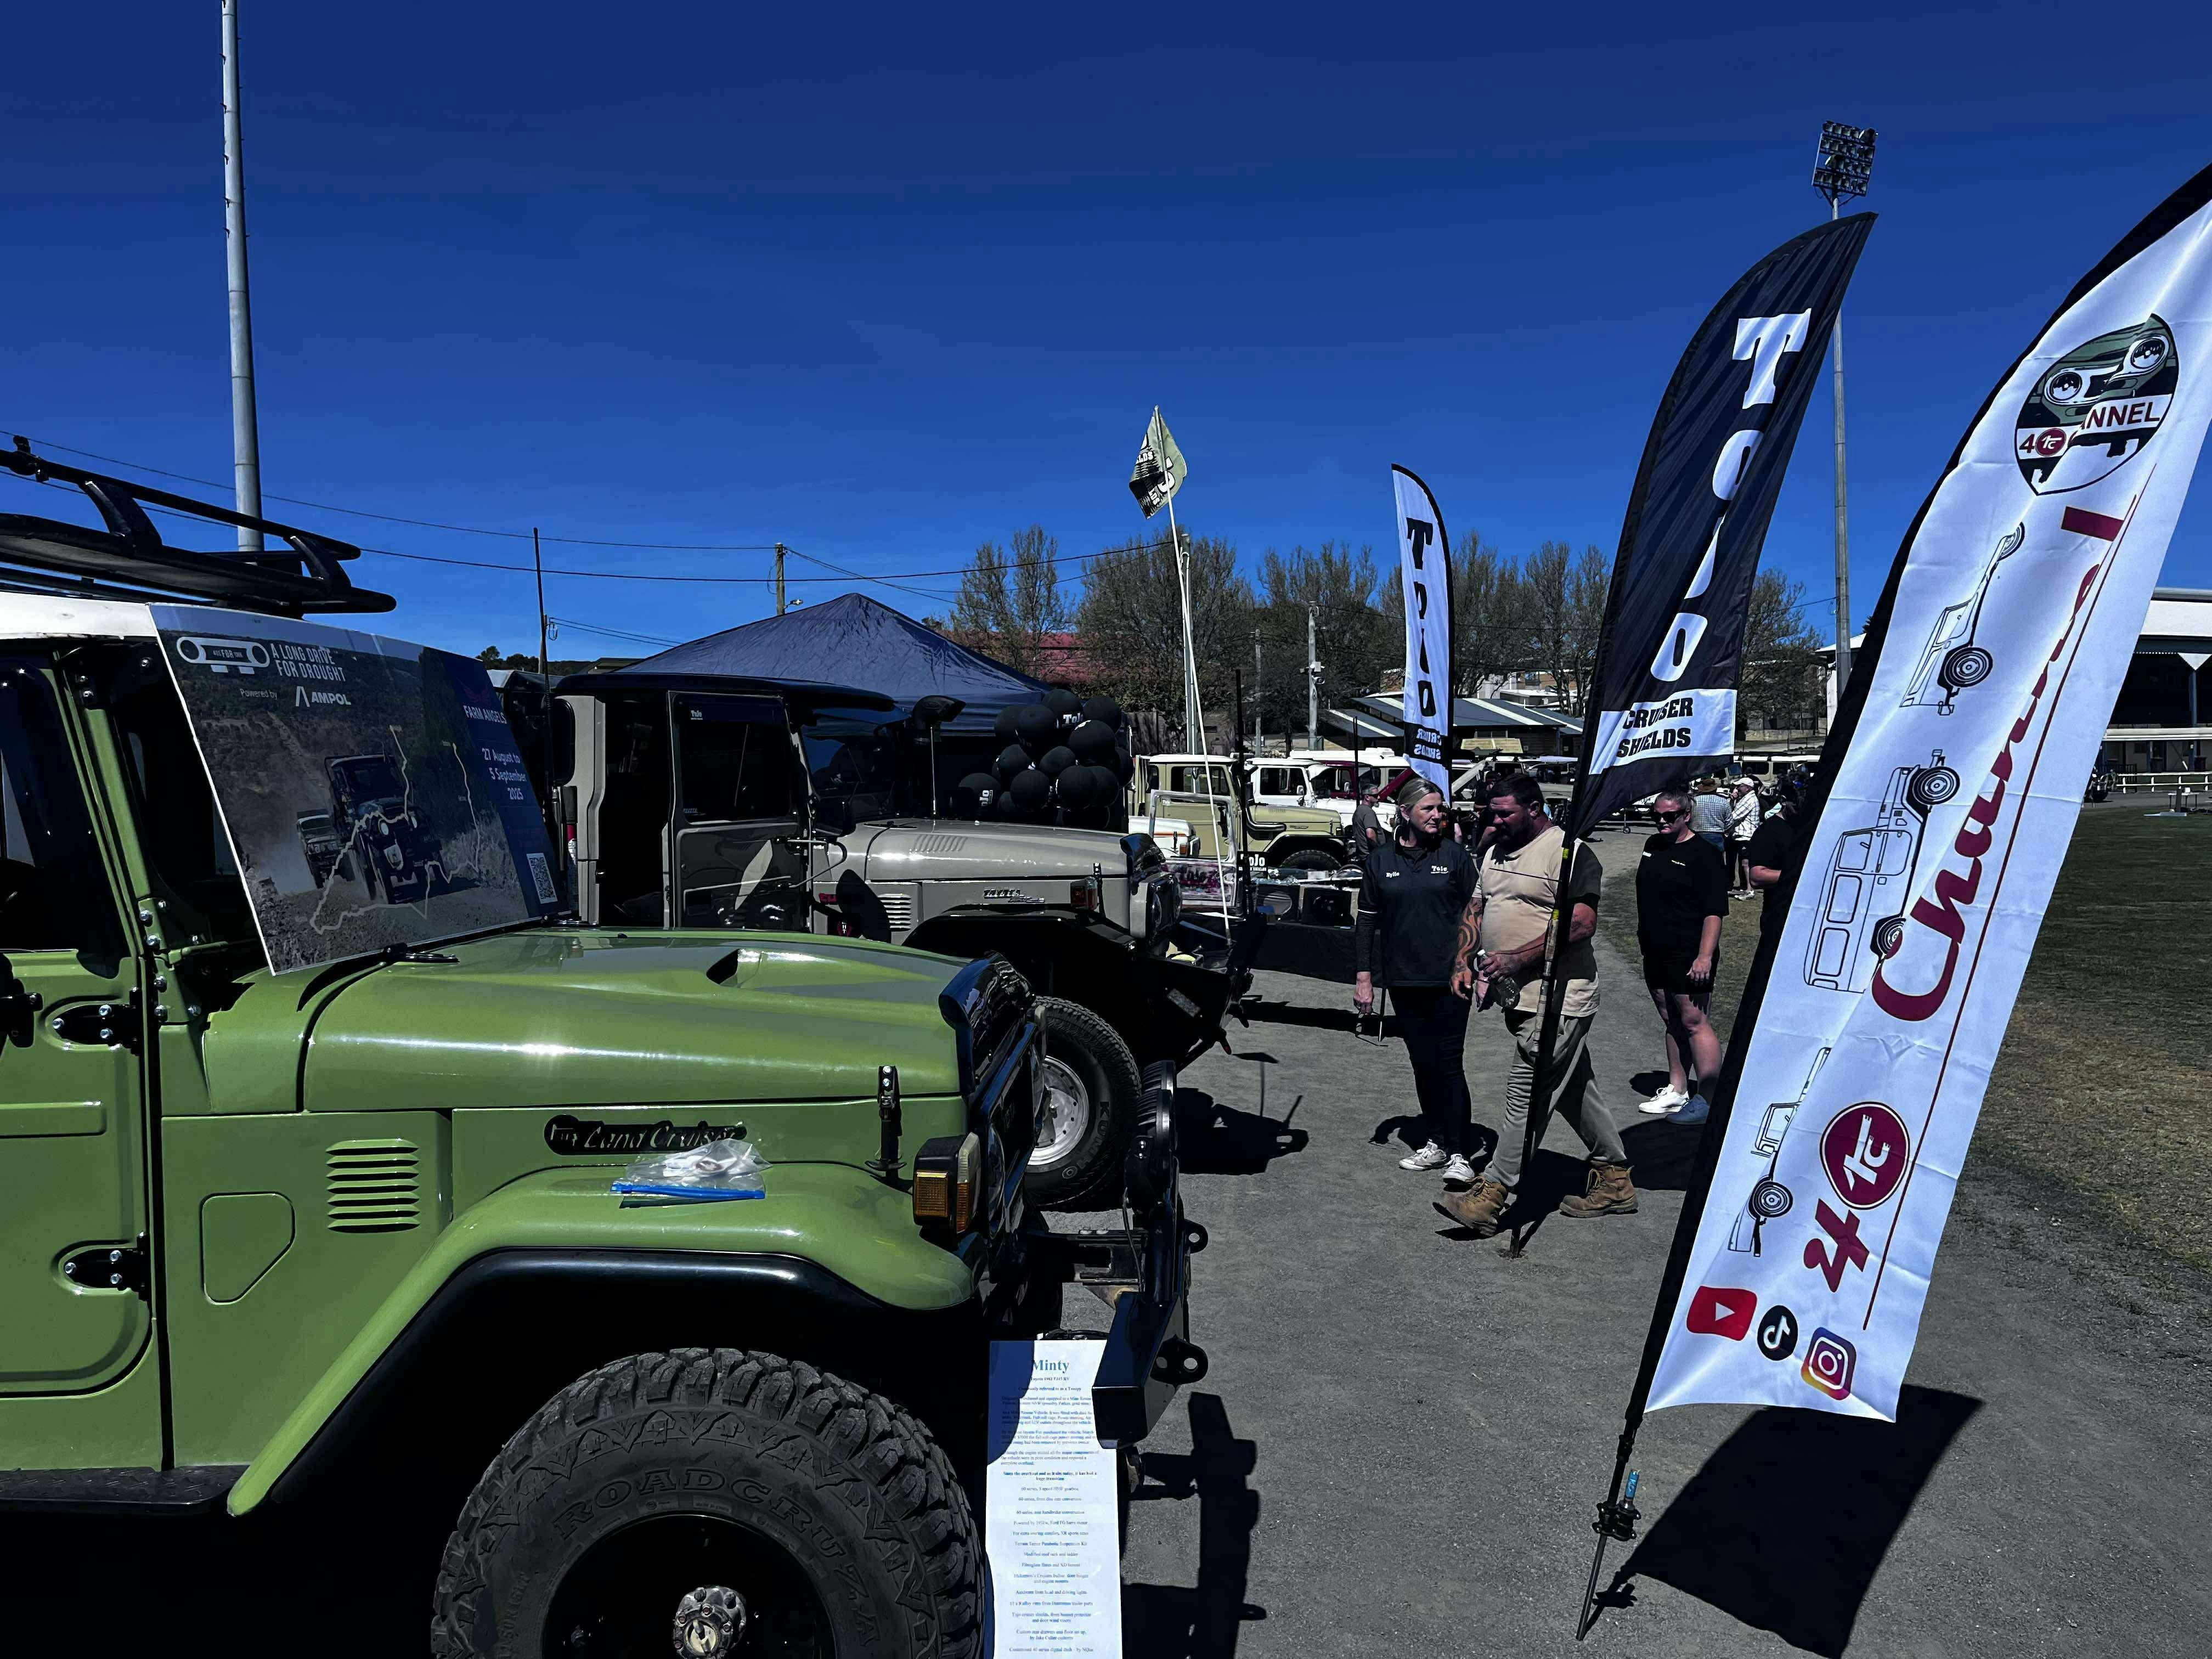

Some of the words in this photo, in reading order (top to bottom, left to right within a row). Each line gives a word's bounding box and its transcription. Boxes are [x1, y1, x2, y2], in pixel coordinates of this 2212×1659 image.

[270, 644, 279, 659] A
[279, 644, 306, 661] LONG
[306, 647, 335, 664] DRIVE
[275, 659, 299, 677] FOR
[298, 662, 346, 681] DROUGHT
[240, 688, 268, 698] Powered
[269, 689, 277, 700] by
[312, 691, 352, 706] AMPOL
[463, 705, 484, 720] FARM
[483, 708, 507, 724] ANGELS
[1623, 697, 1694, 730] CRUISER
[1616, 727, 1691, 758] SHIELDS
[482, 747, 492, 760] 27
[492, 749, 513, 765] August
[513, 752, 521, 764] to
[489, 768, 496, 780] 5
[497, 768, 527, 783] September
[507, 788, 523, 800] 2025
[1032, 1359, 1070, 1373] Minty
